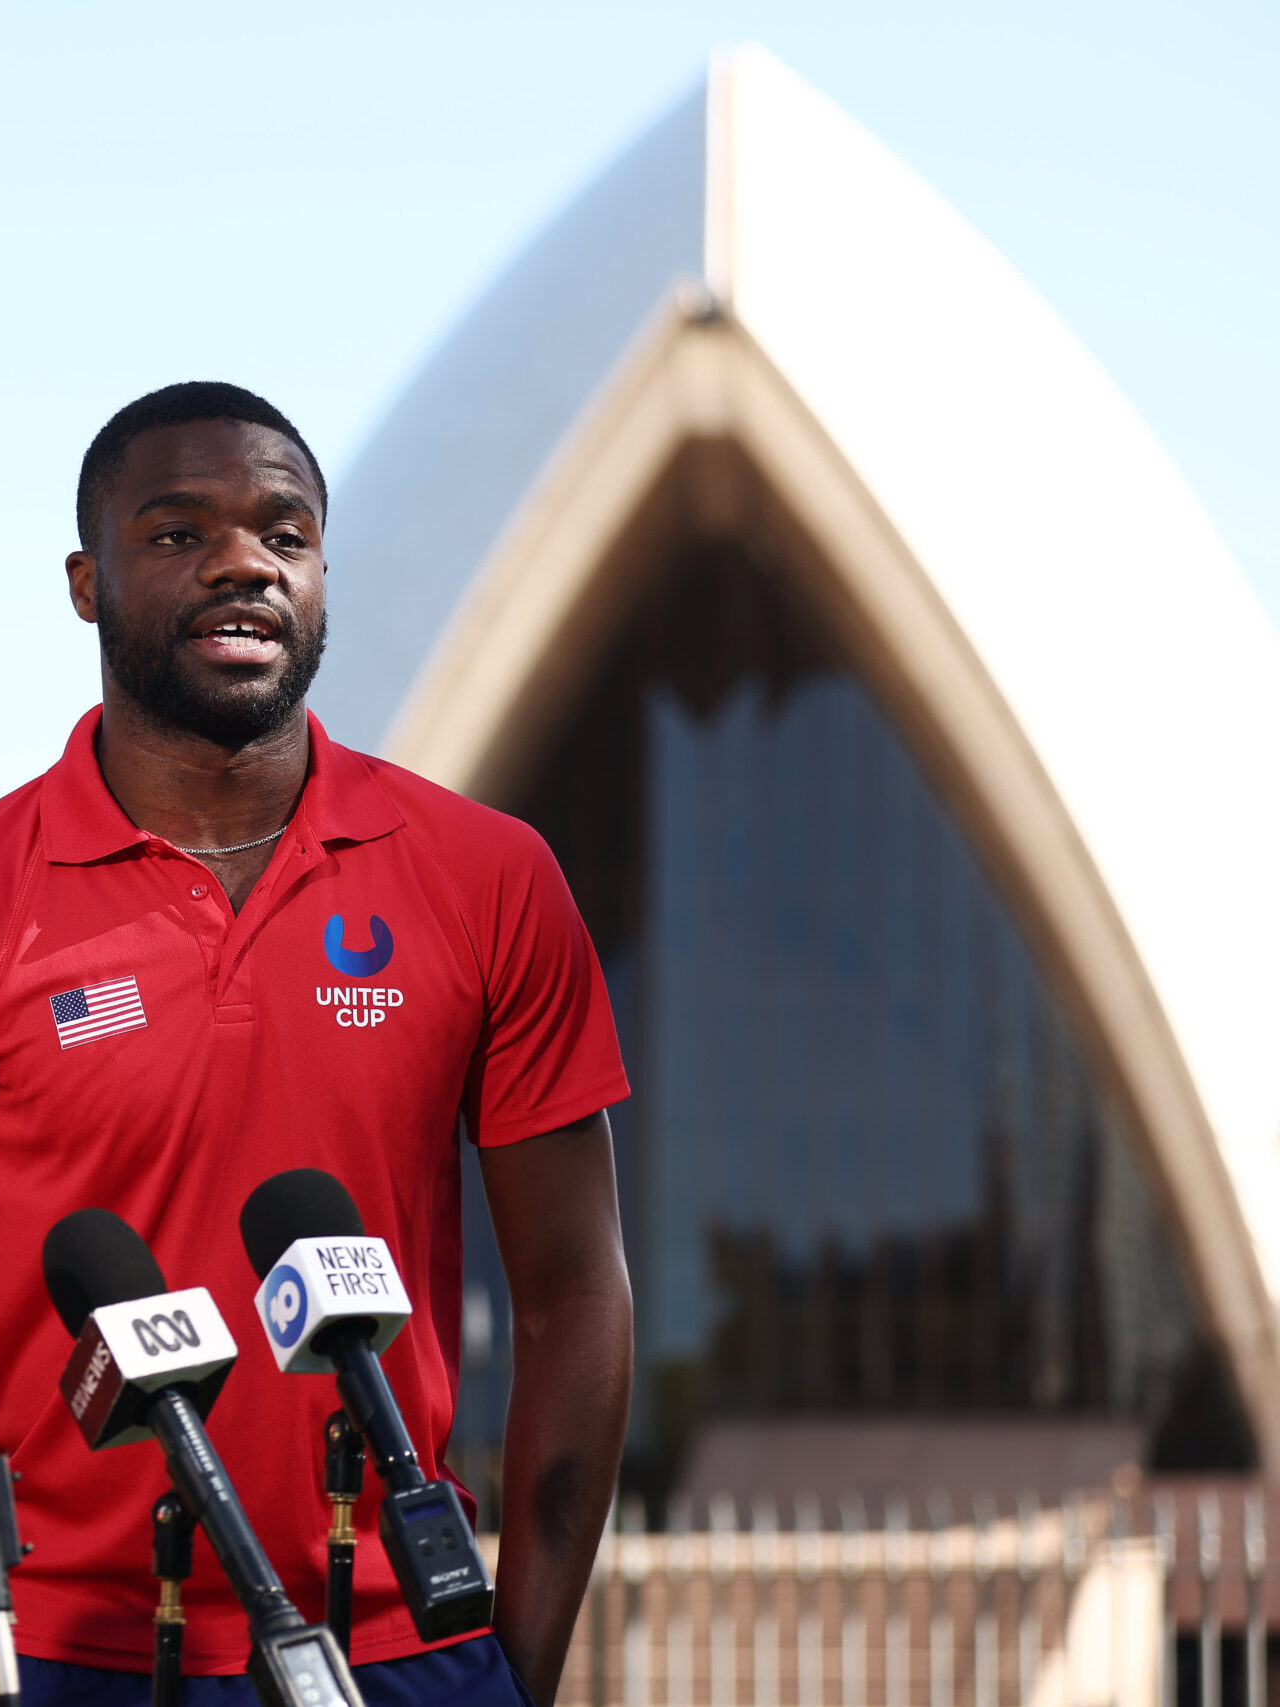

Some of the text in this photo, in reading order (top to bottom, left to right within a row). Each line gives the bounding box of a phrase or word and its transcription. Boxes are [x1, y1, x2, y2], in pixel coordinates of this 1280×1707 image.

[315, 986, 404, 1007] UNITED
[336, 1008, 386, 1028] CUP
[316, 1246, 383, 1270] NEWS
[326, 1272, 390, 1296] FIRST
[429, 1565, 470, 1585] SONY
